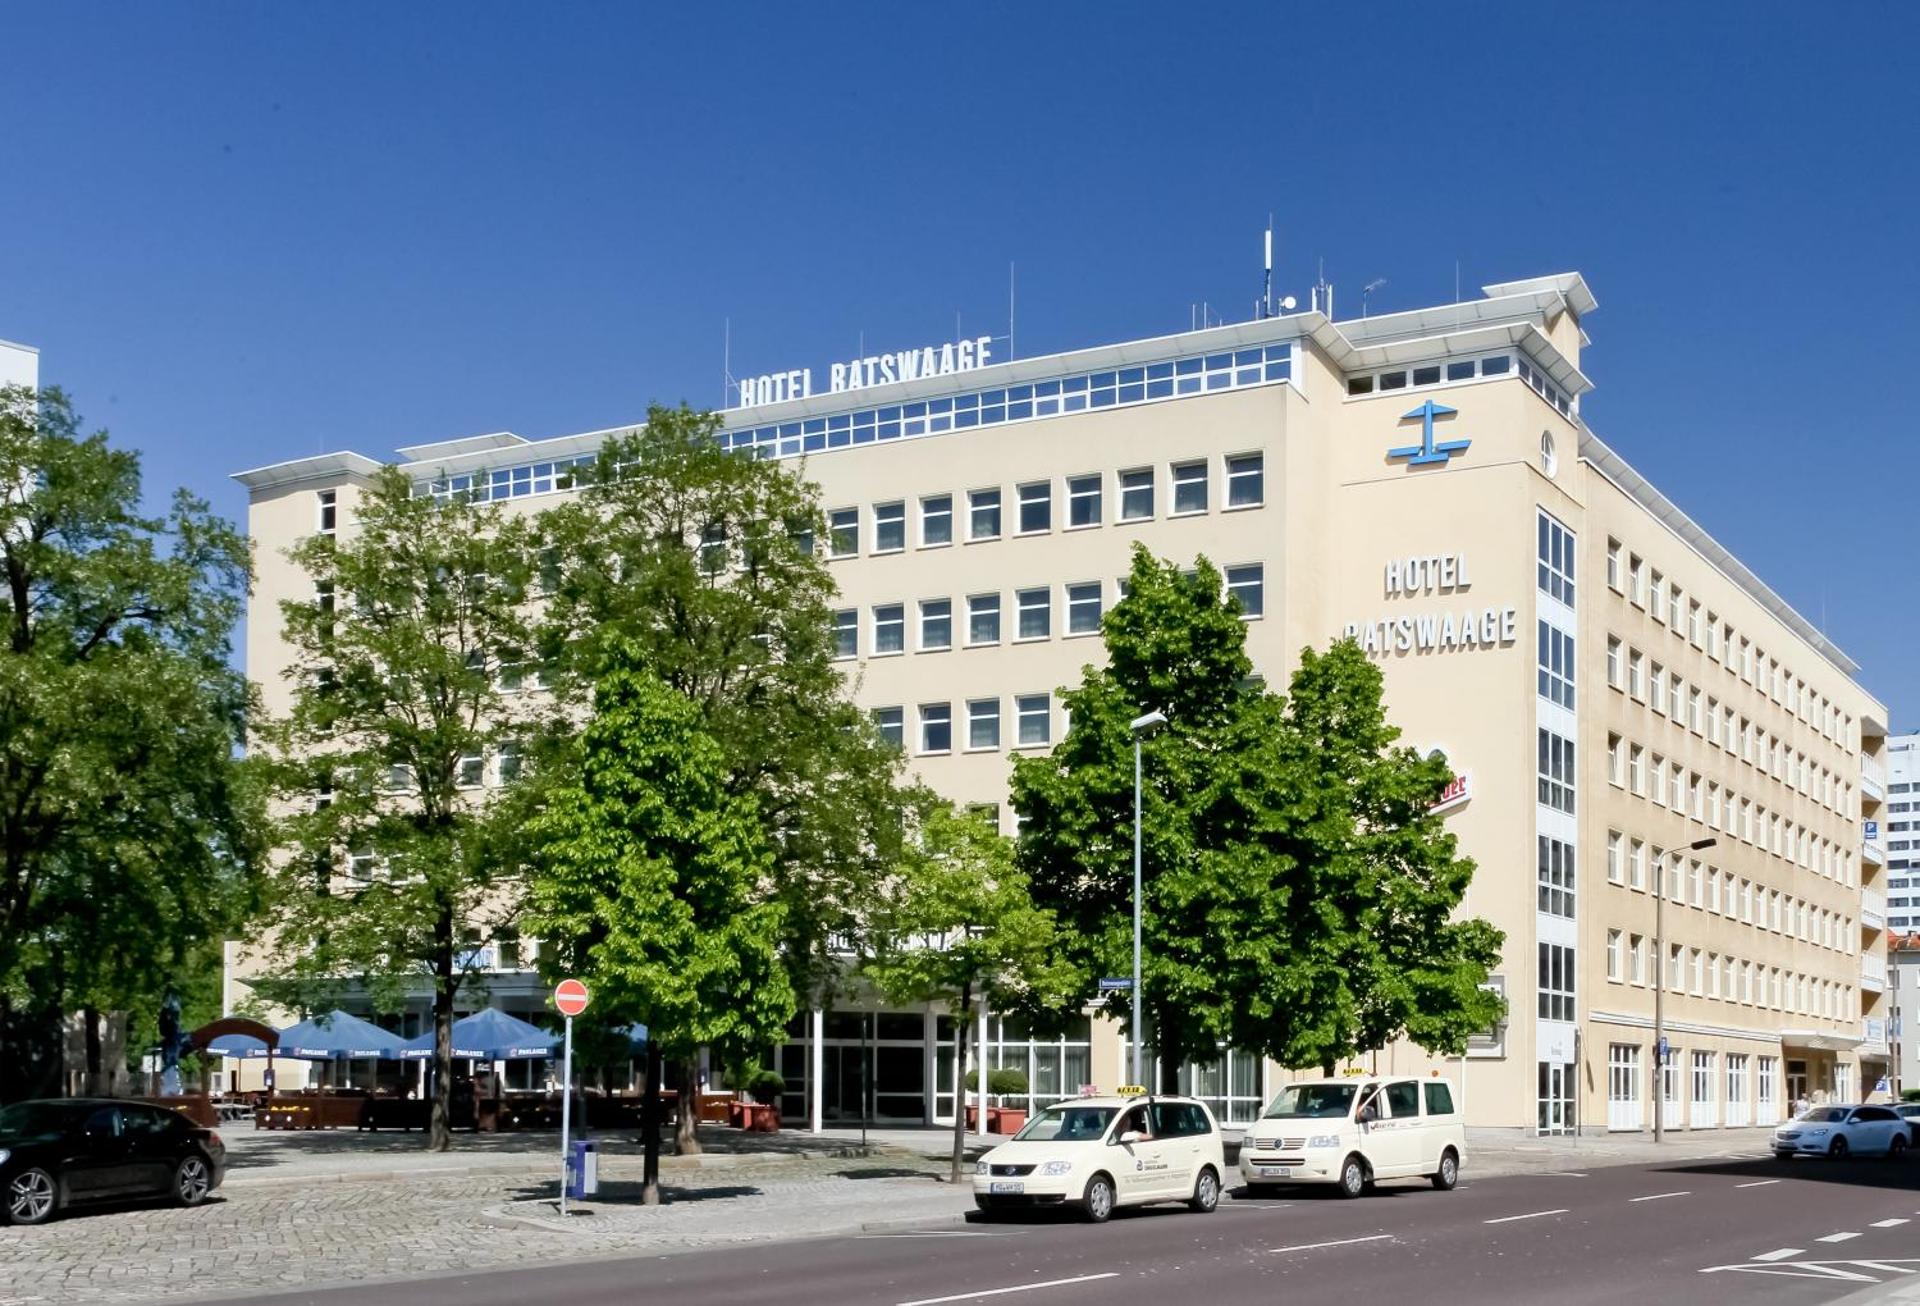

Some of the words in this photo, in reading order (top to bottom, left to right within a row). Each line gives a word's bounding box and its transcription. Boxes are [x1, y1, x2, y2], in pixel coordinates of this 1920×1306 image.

[740, 367, 811, 408] HOTEL
[831, 336, 992, 394] RATSWAAGE
[1384, 552, 1472, 594] HOTEL
